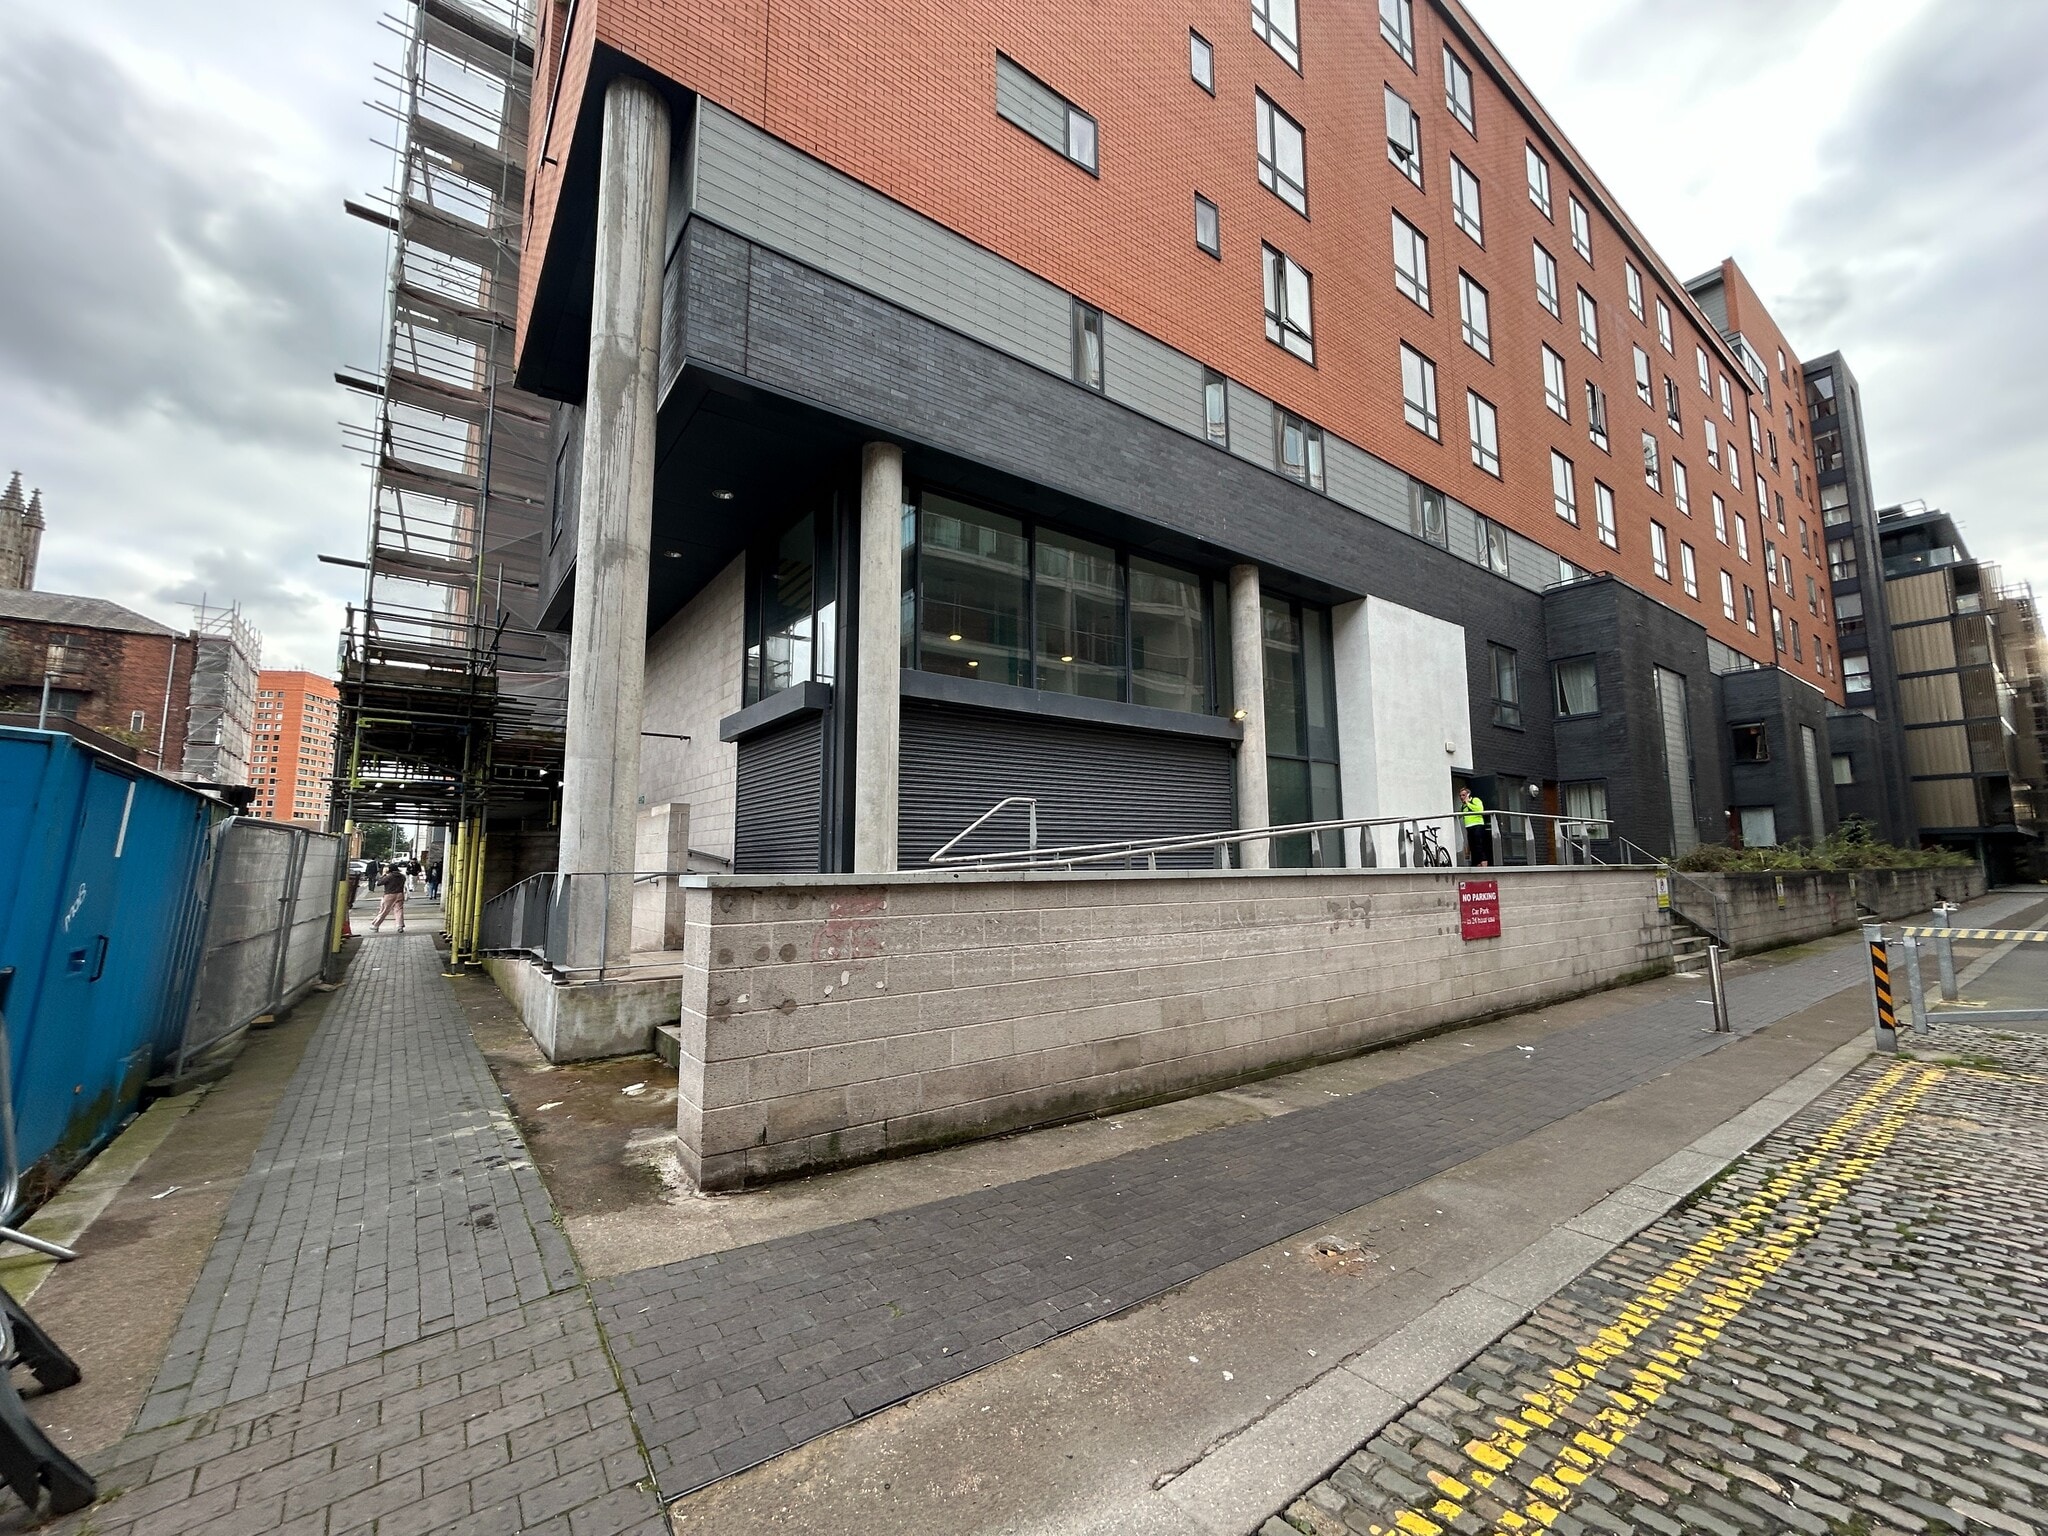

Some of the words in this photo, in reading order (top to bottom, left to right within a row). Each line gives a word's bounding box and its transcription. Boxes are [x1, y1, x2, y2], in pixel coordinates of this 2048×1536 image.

[1462, 893, 1471, 902] NO
[1472, 892, 1496, 901] PARKING
[1479, 907, 1489, 915] Park
